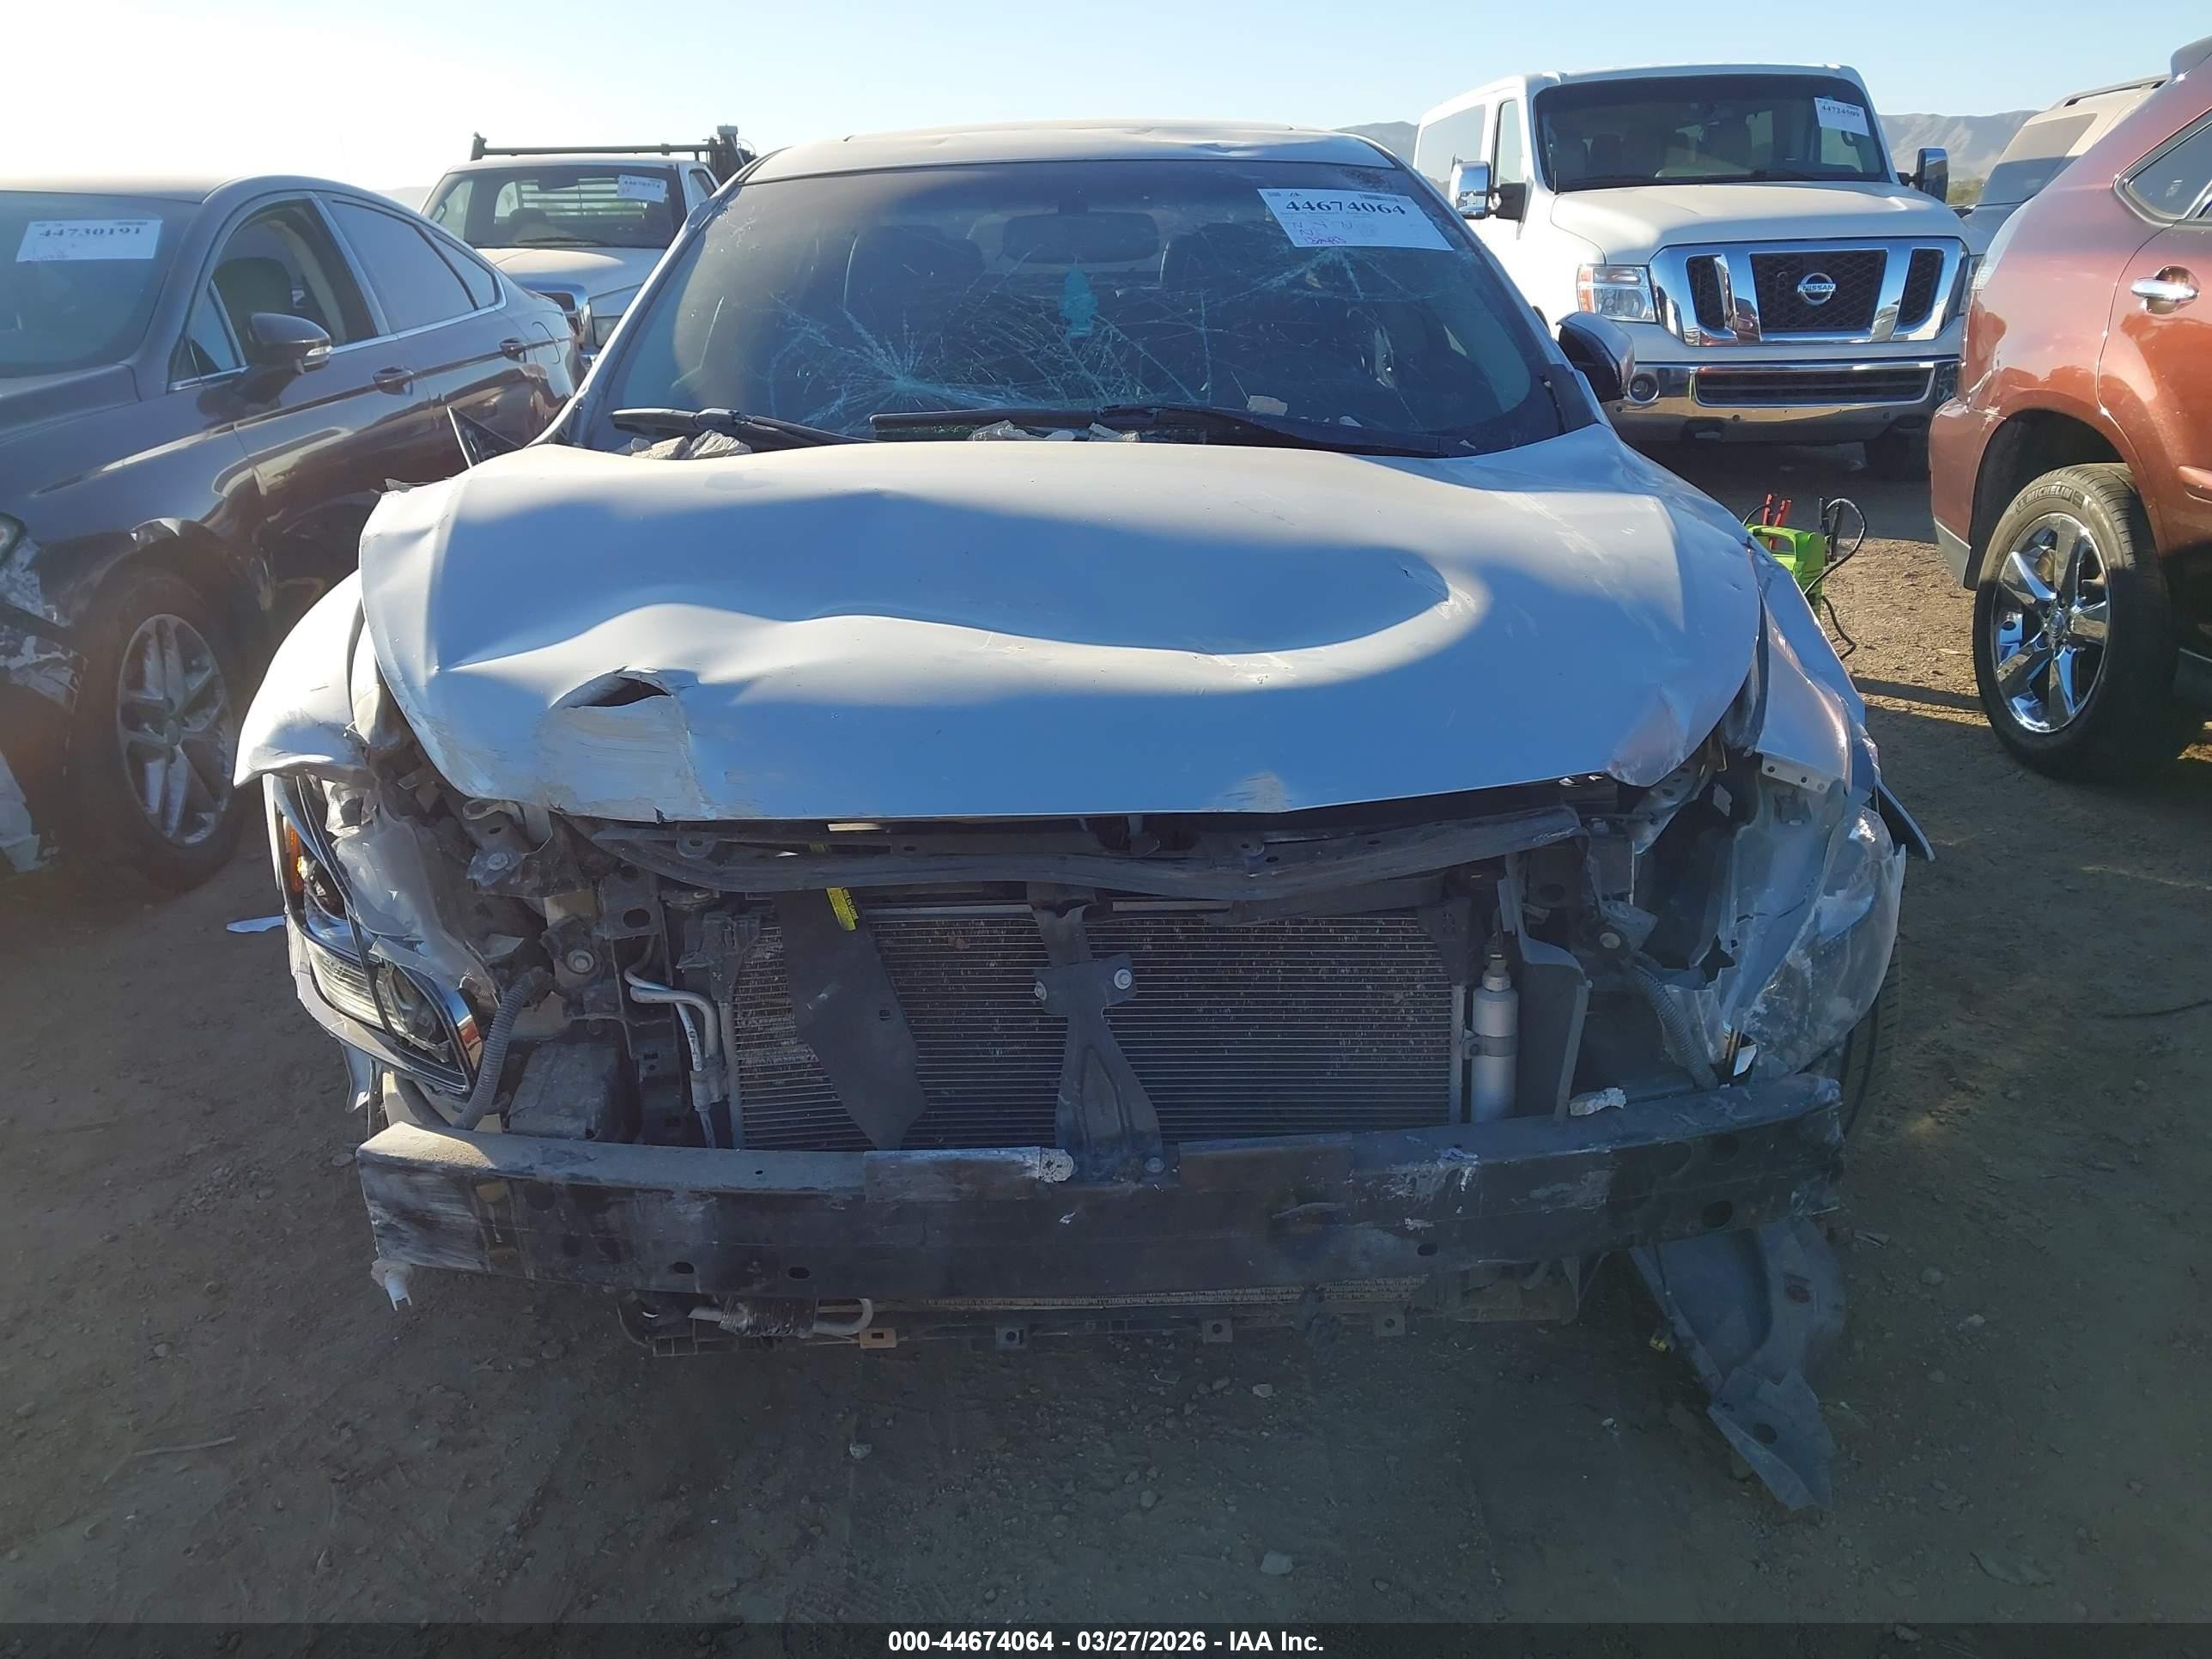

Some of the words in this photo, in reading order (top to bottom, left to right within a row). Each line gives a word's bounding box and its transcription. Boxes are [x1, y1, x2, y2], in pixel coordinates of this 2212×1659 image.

[1285, 200, 1406, 215] 44674064
[39, 228, 141, 237] 44730191
[2026, 485, 2074, 504] MICHELIN
